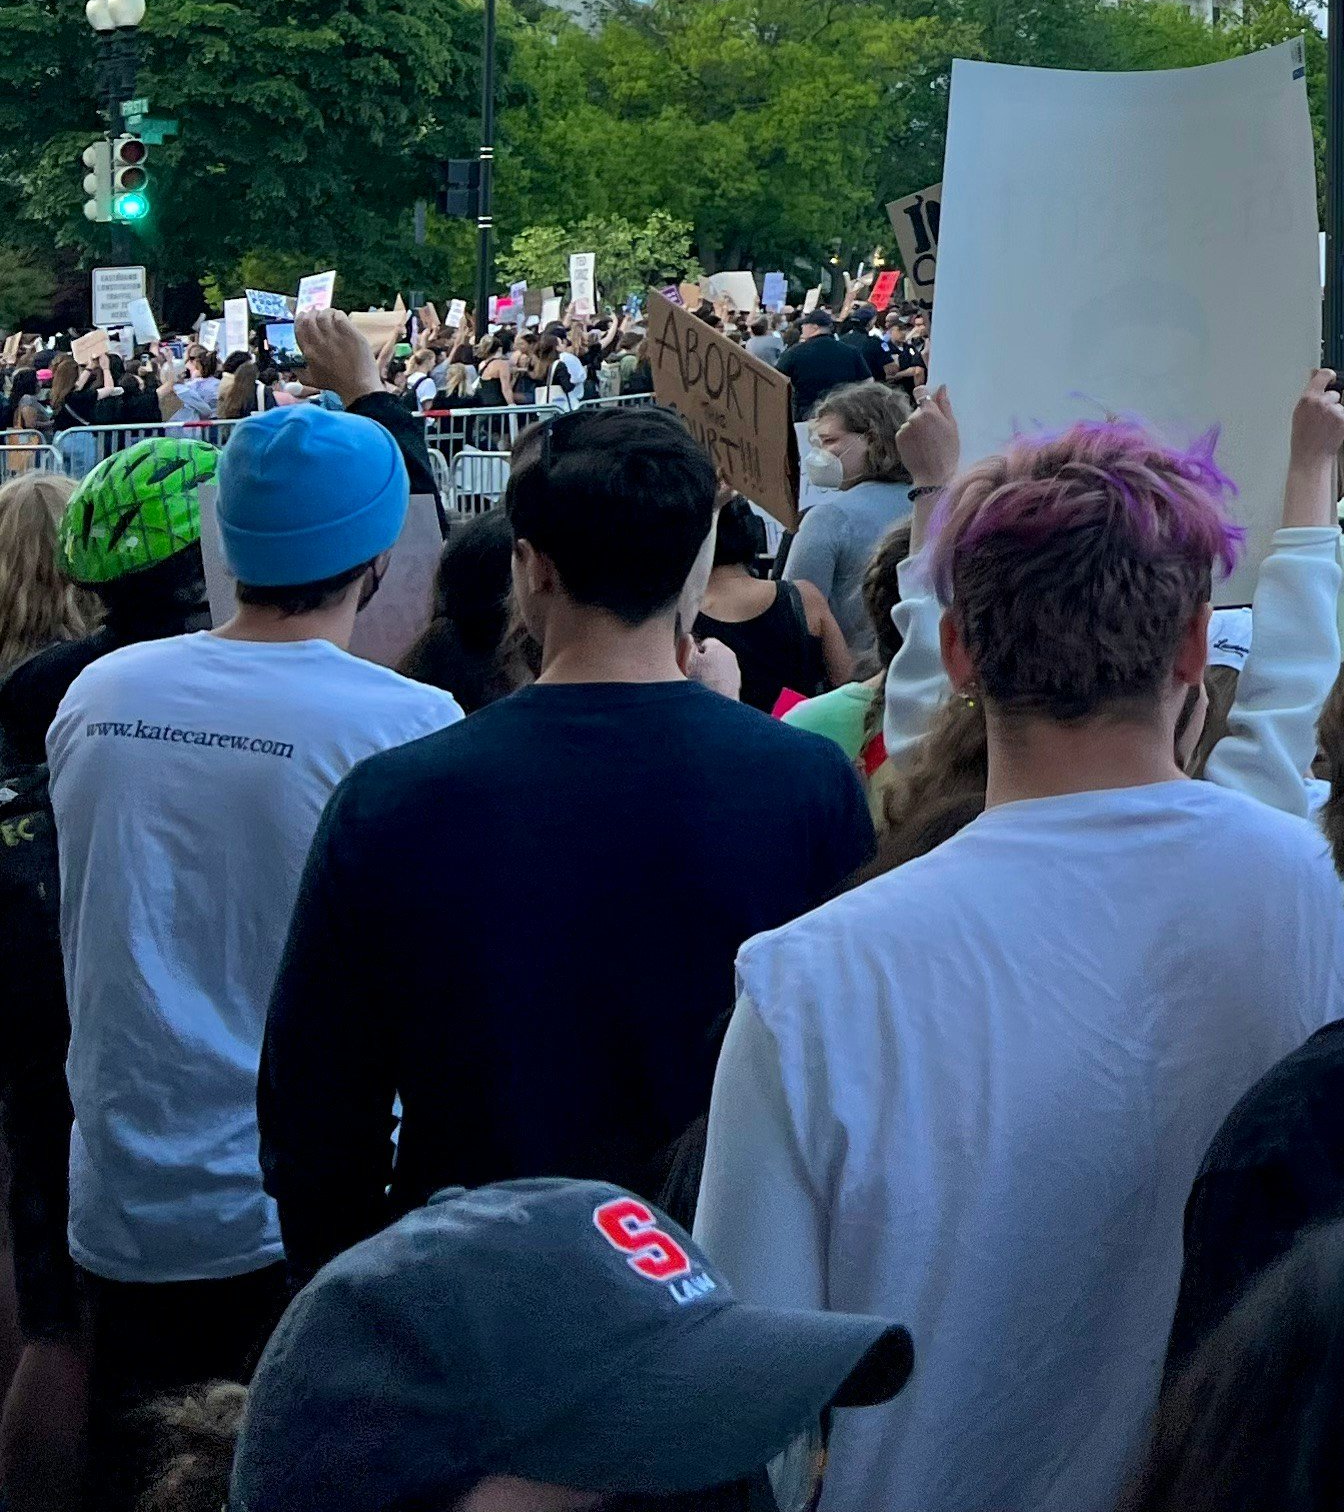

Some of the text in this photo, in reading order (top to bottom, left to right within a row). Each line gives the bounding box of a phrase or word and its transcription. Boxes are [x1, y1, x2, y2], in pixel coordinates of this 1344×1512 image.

[654, 310, 776, 437] ABORT
[86, 719, 294, 759] www.katecarew.com
[592, 1195, 692, 1283] S
[668, 1272, 717, 1307] LAW
